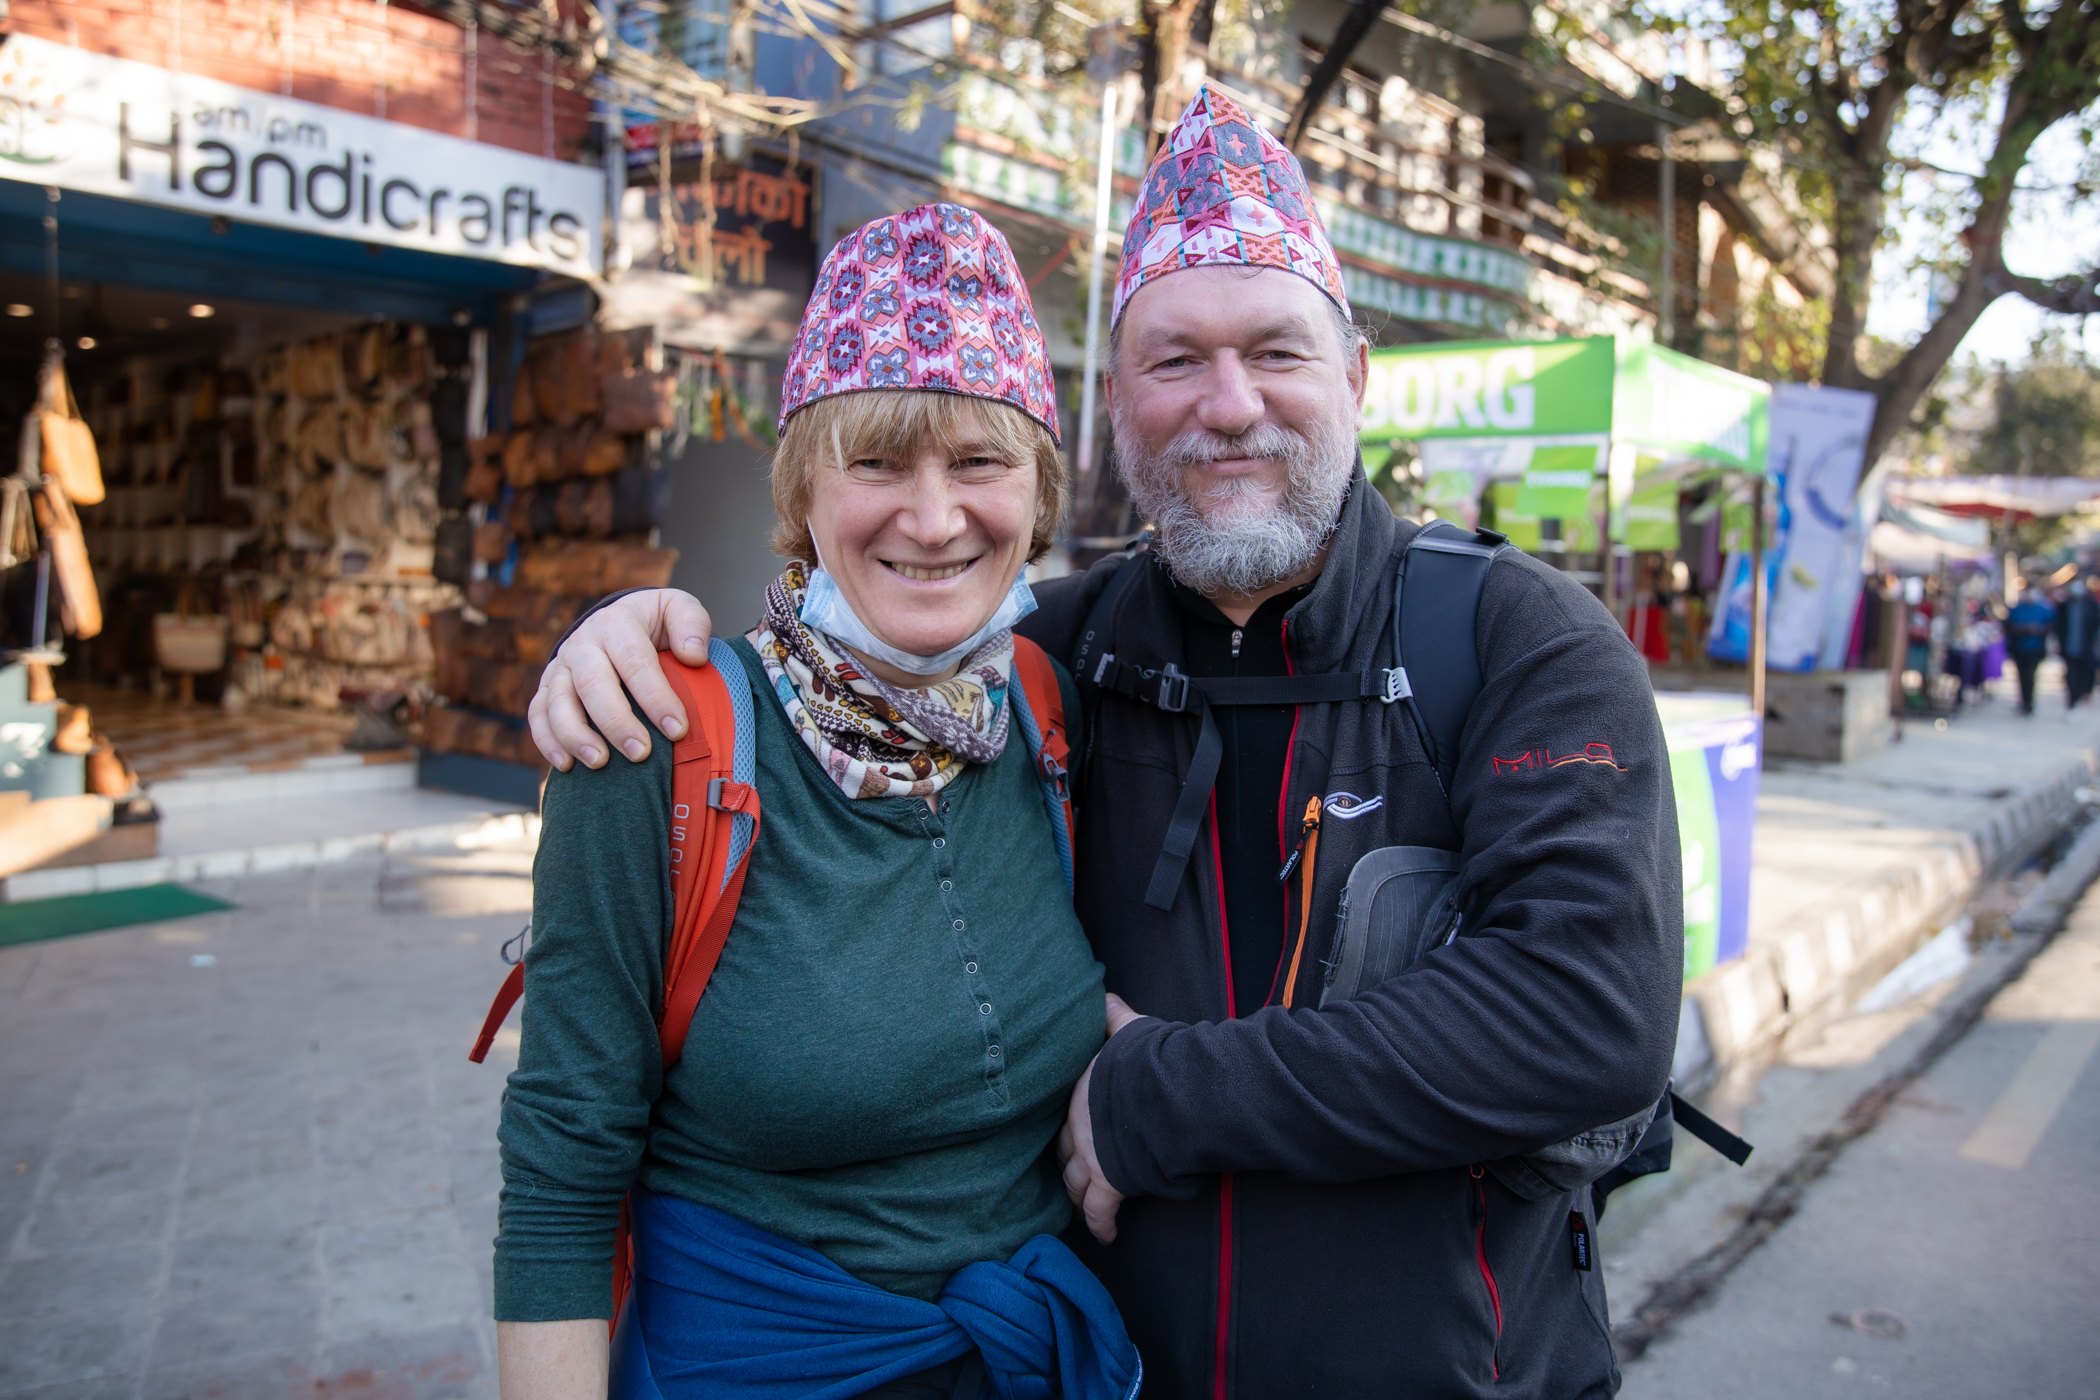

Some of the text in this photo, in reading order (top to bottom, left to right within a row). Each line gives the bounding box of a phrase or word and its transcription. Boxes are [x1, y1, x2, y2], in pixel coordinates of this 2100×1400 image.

[118, 102, 582, 262] Handicrafts
[1279, 850, 1299, 880] POLARTEC
[1577, 1232, 1587, 1267] POLARTEC
